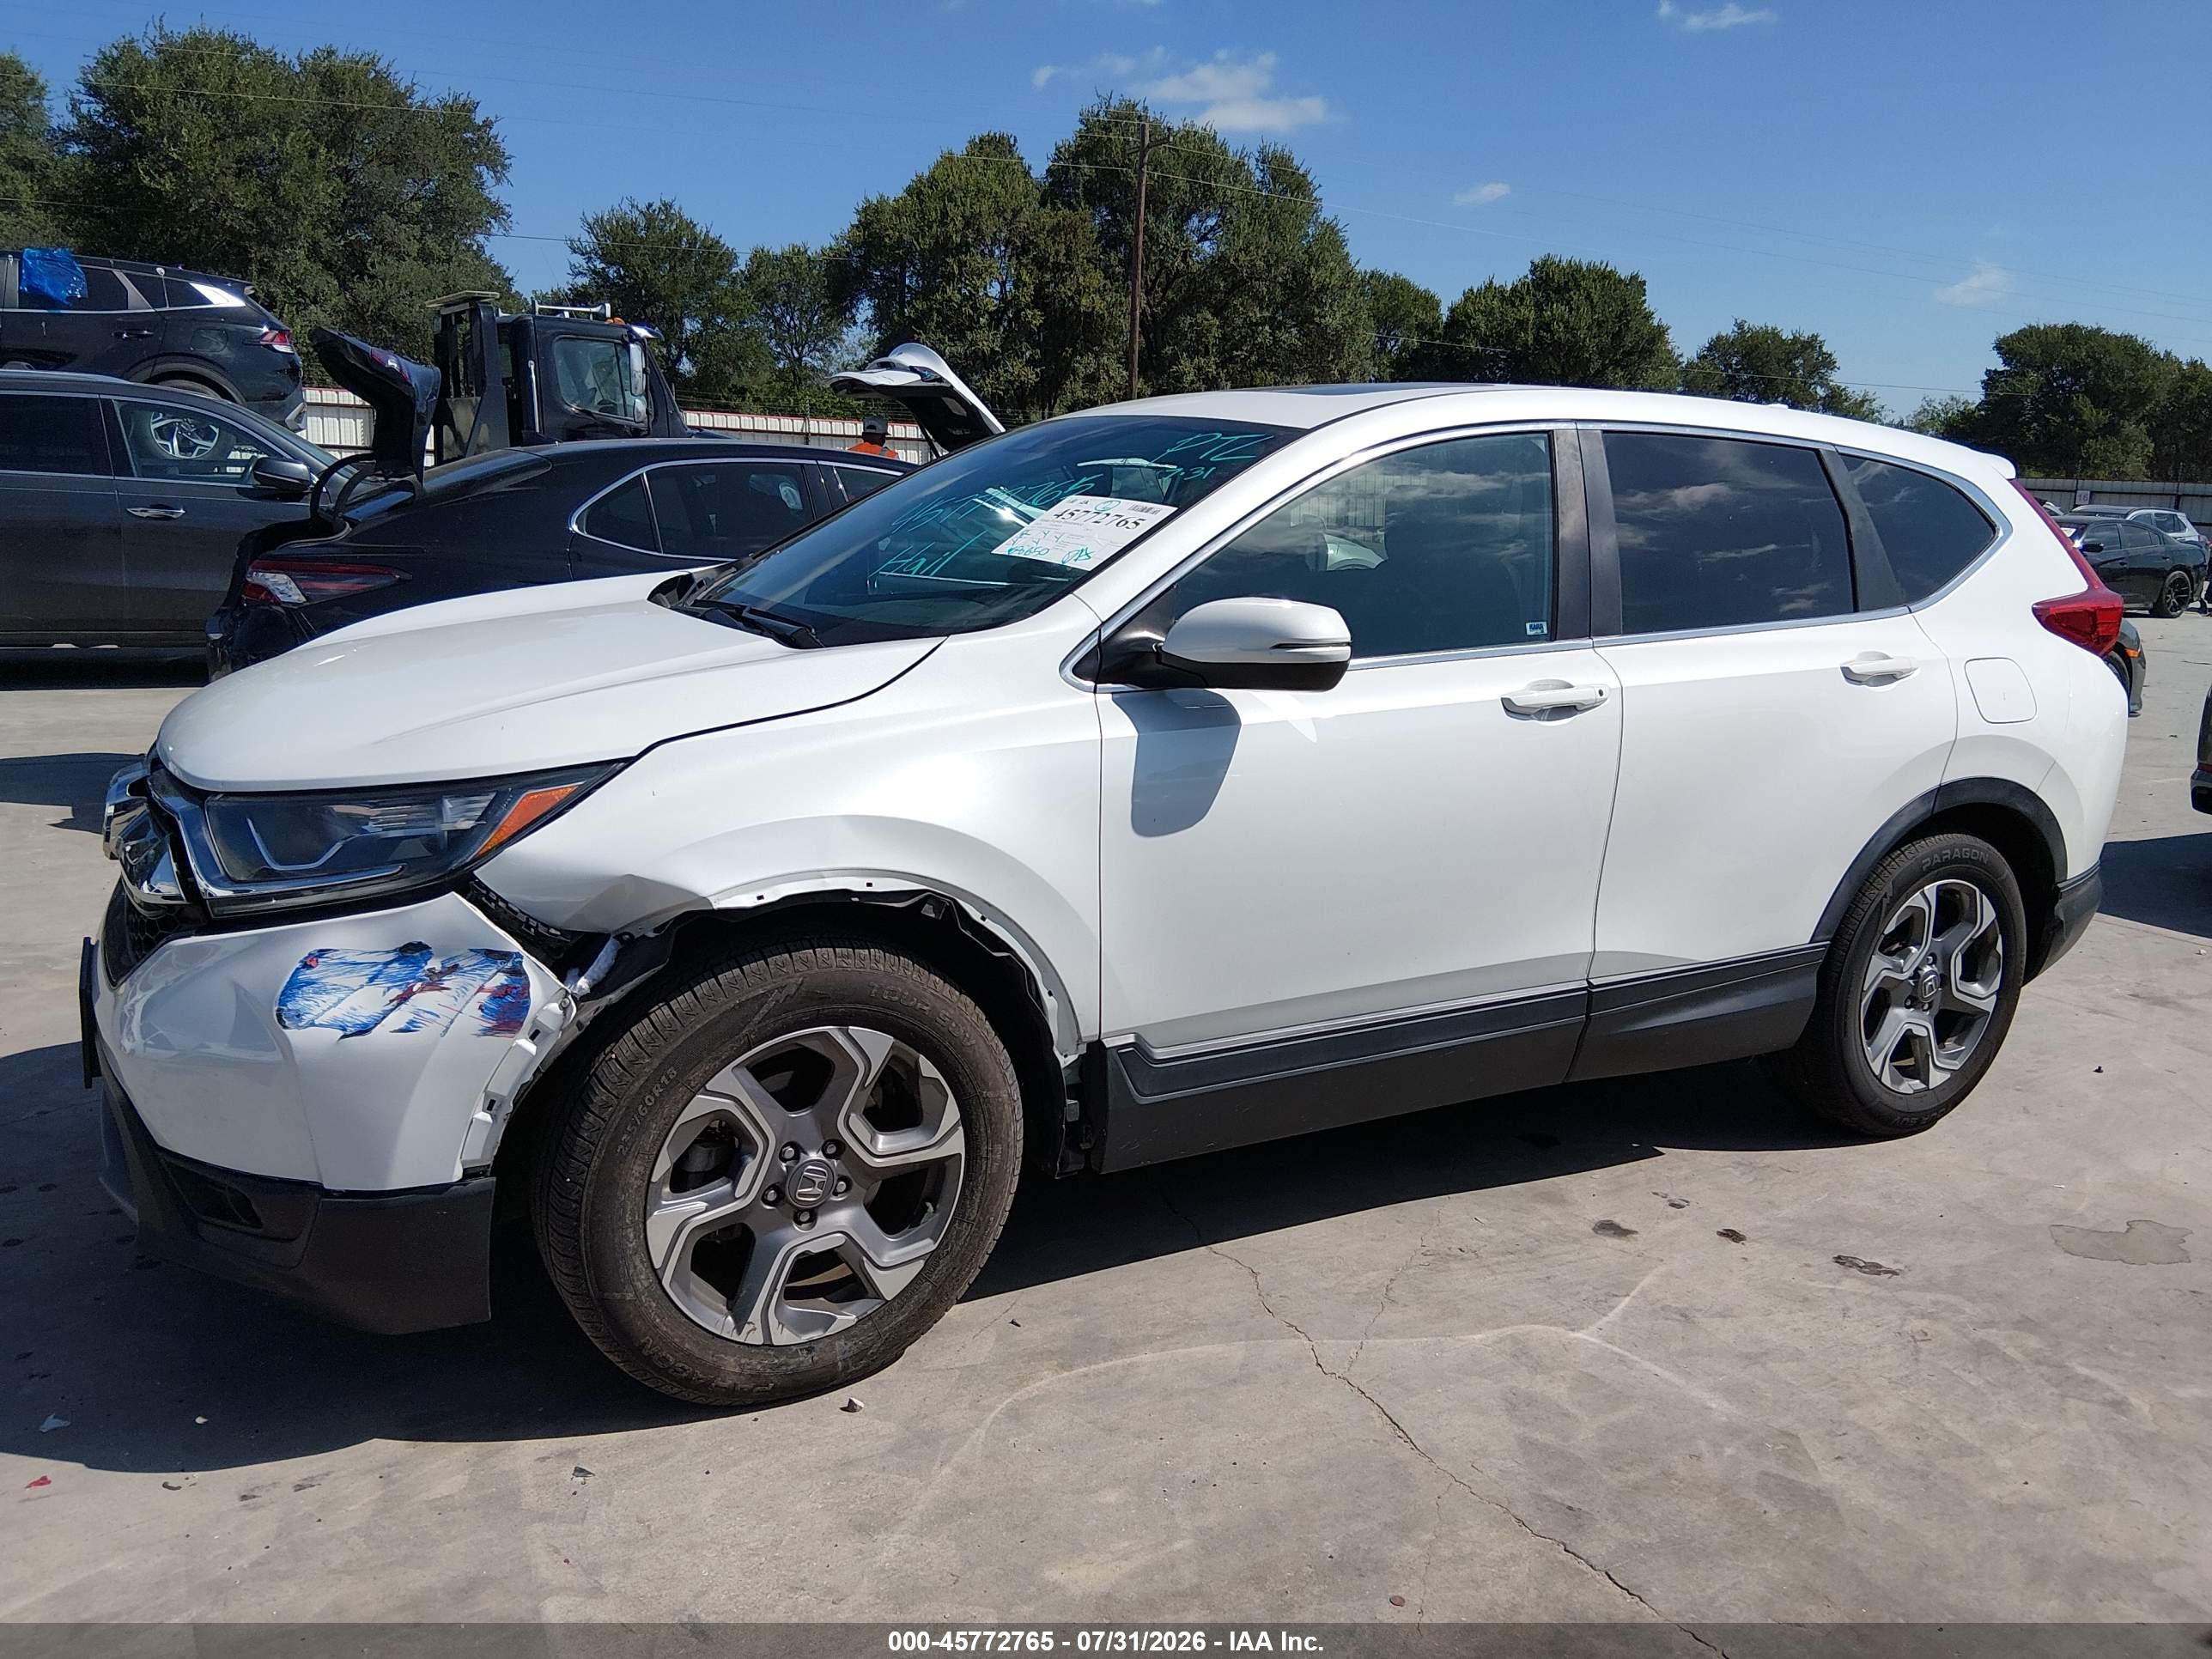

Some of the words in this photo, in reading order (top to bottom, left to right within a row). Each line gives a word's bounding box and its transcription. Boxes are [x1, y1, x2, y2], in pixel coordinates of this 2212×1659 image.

[1053, 508, 1148, 531] 45772765
[867, 529, 988, 578] Hail
[1921, 847, 1990, 872] PARAGON
